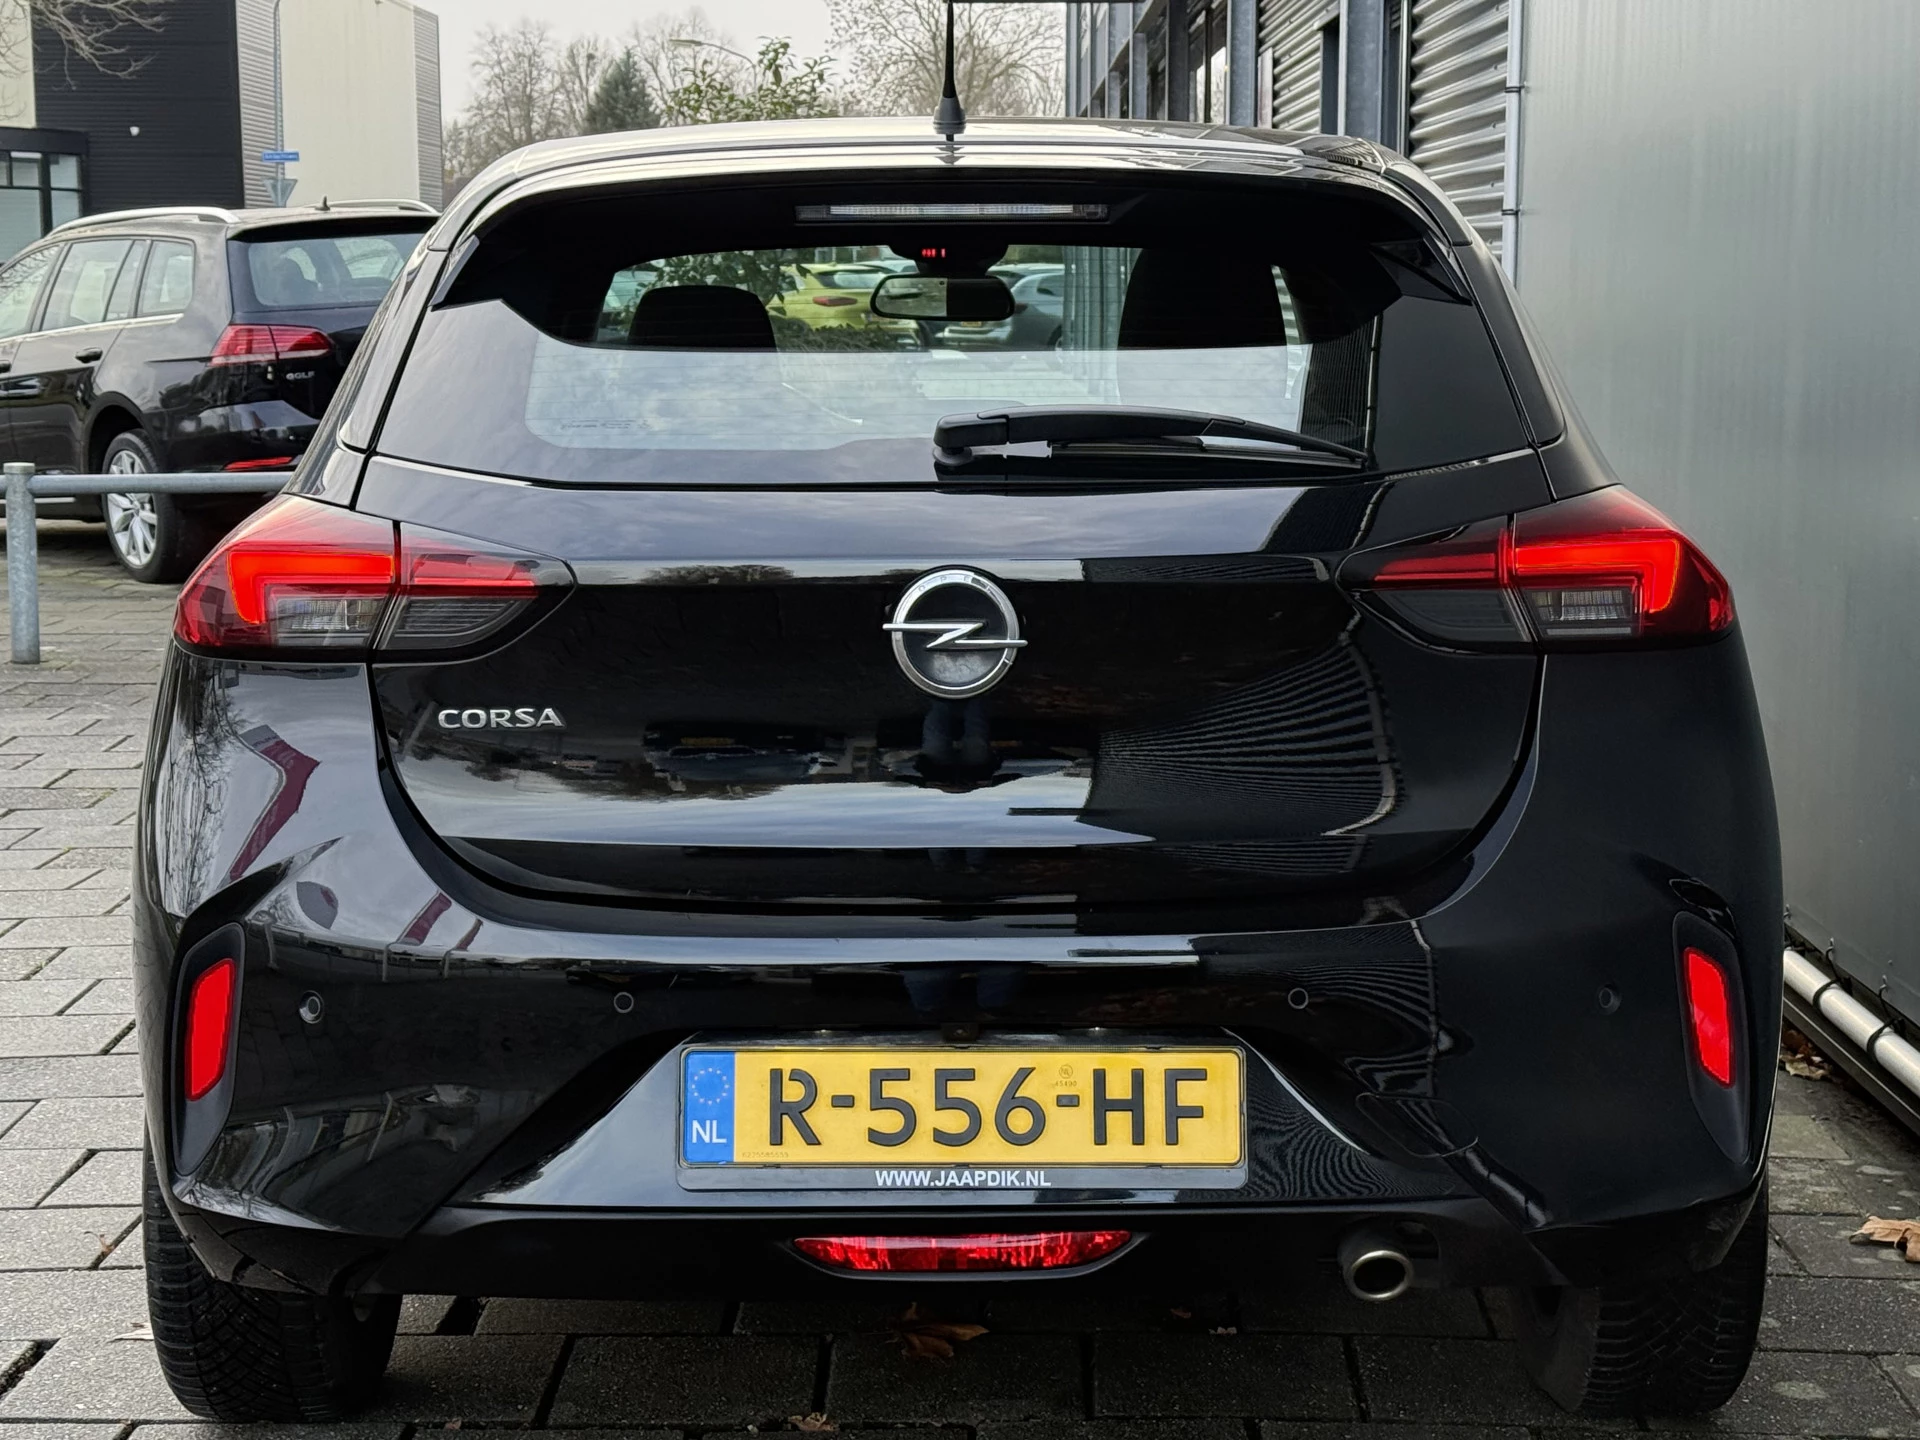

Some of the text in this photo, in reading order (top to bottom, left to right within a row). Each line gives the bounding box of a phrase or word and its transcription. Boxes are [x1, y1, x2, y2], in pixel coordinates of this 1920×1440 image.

[438, 708, 565, 729] CORSA
[768, 1067, 1208, 1146] R-556-HF
[691, 1119, 728, 1144] NL
[874, 1169, 1052, 1187] WWW.JAAPDIK.NL
